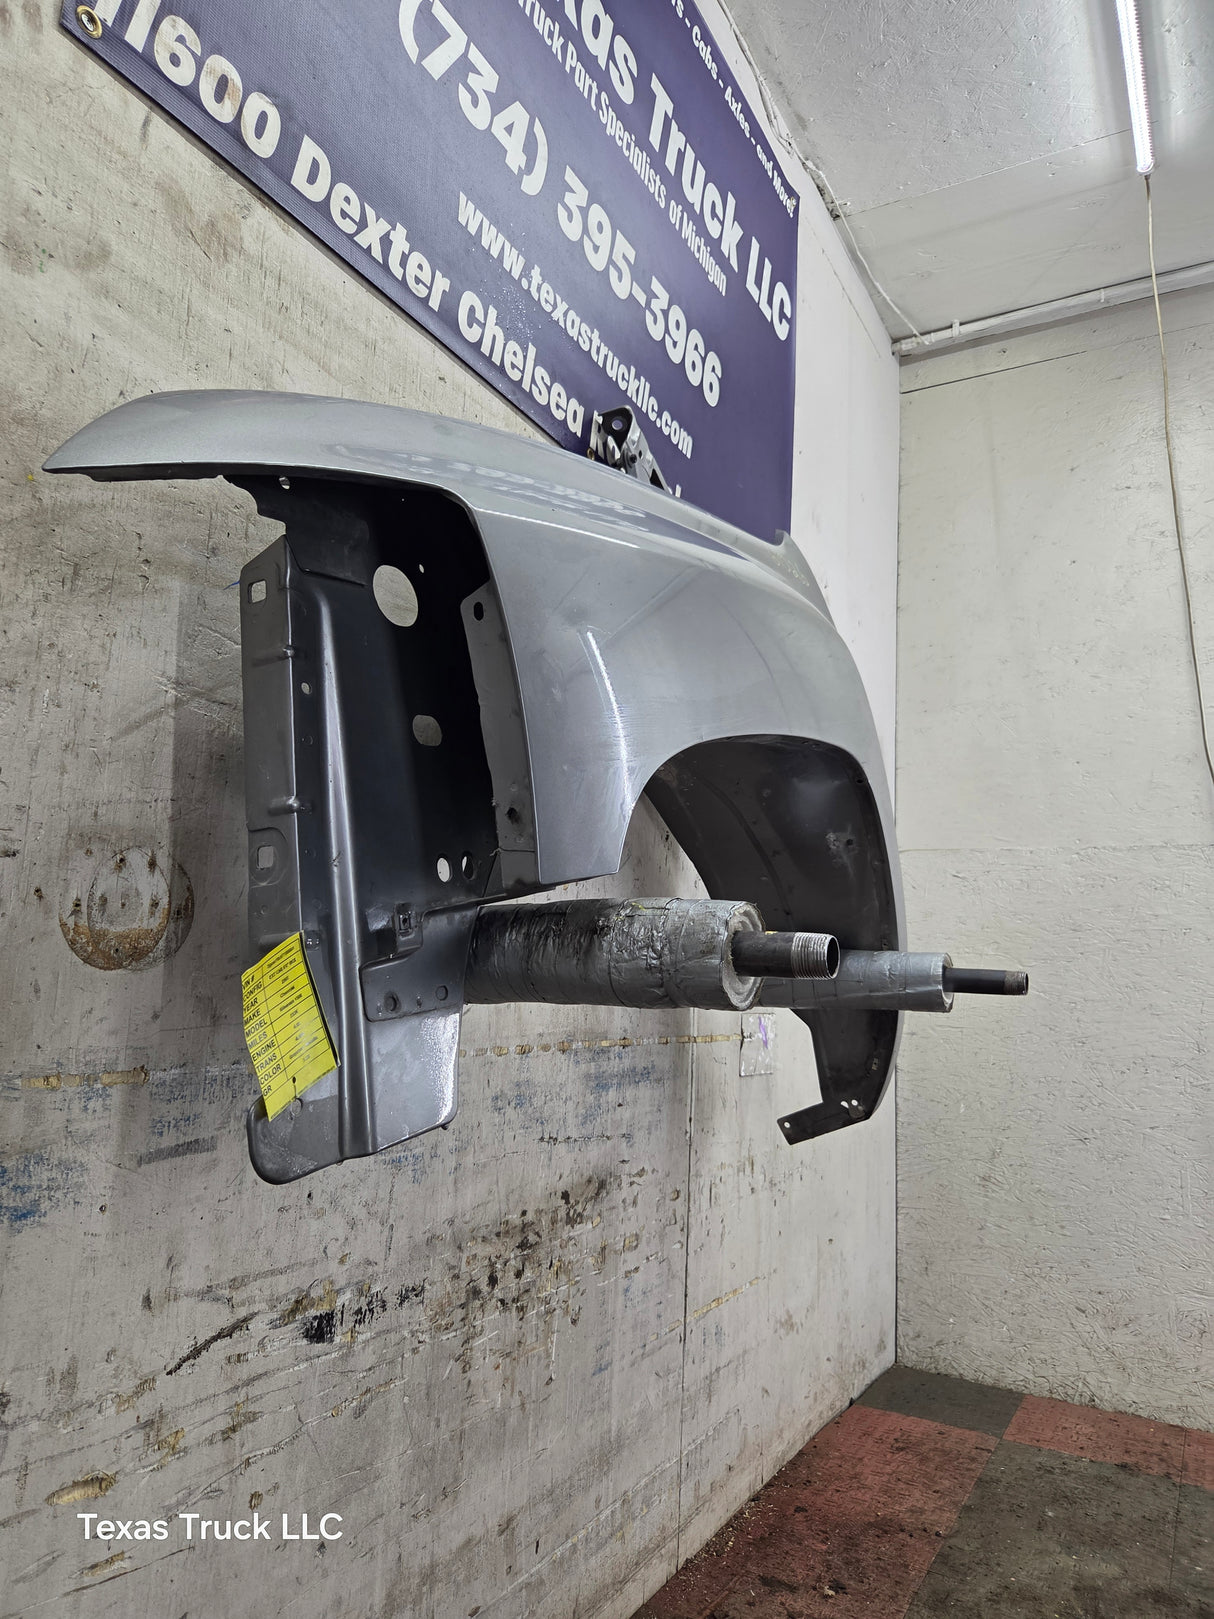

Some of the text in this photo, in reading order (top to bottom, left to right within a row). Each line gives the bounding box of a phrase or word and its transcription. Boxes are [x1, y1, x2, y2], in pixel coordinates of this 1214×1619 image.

[692, 25, 718, 80] Cabs
[725, 86, 750, 138] Axles
[756, 144, 773, 179] and
[565, 40, 599, 111] Part
[599, 91, 666, 208] Specialists
[669, 199, 683, 231] of
[681, 211, 728, 296] Michigan
[398, 0, 722, 407] (734) 395-3966
[649, 72, 744, 272] Truck
[746, 236, 792, 341] LLC
[290, 134, 450, 312] Dexter
[458, 290, 585, 438] Chelsea
[458, 191, 693, 459] www.texastruckllc.com
[243, 997, 258, 1014] YEAR
[244, 1008, 261, 1025] MAKE
[245, 1018, 268, 1037] MODEL
[248, 1031, 268, 1049] MILES
[251, 1039, 276, 1062] ENGINE
[256, 1052, 277, 1073] TRANS
[260, 1063, 282, 1085] COLOR
[263, 1084, 272, 1097] GR
